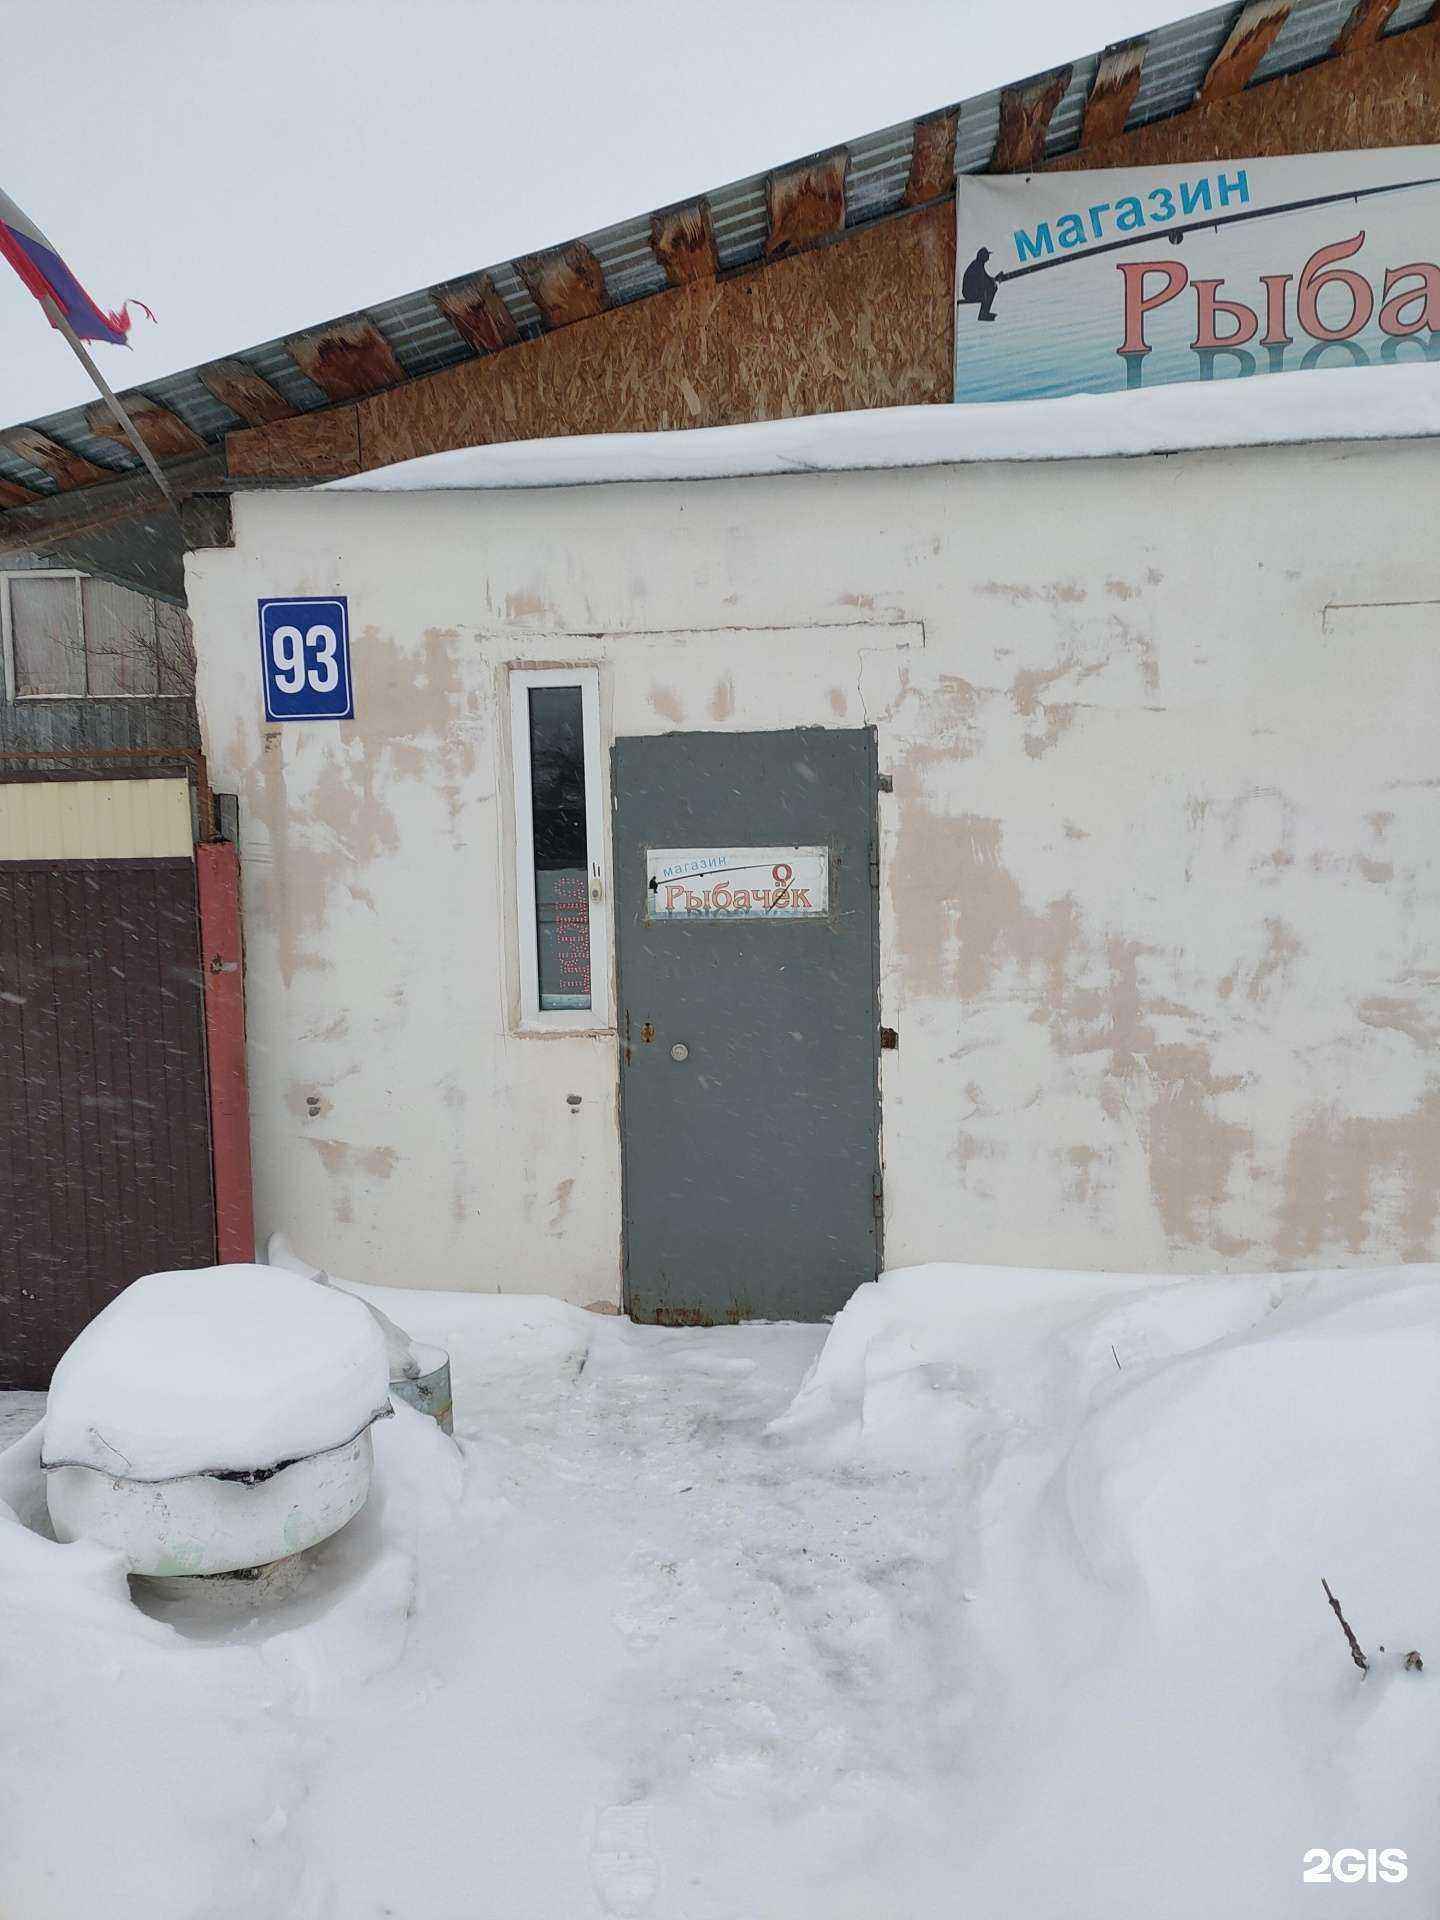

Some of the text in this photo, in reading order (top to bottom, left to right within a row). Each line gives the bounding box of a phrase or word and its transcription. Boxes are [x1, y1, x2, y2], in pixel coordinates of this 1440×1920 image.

[1013, 170, 1251, 263] магазин
[272, 624, 338, 694] 93
[663, 856, 726, 877] магазин
